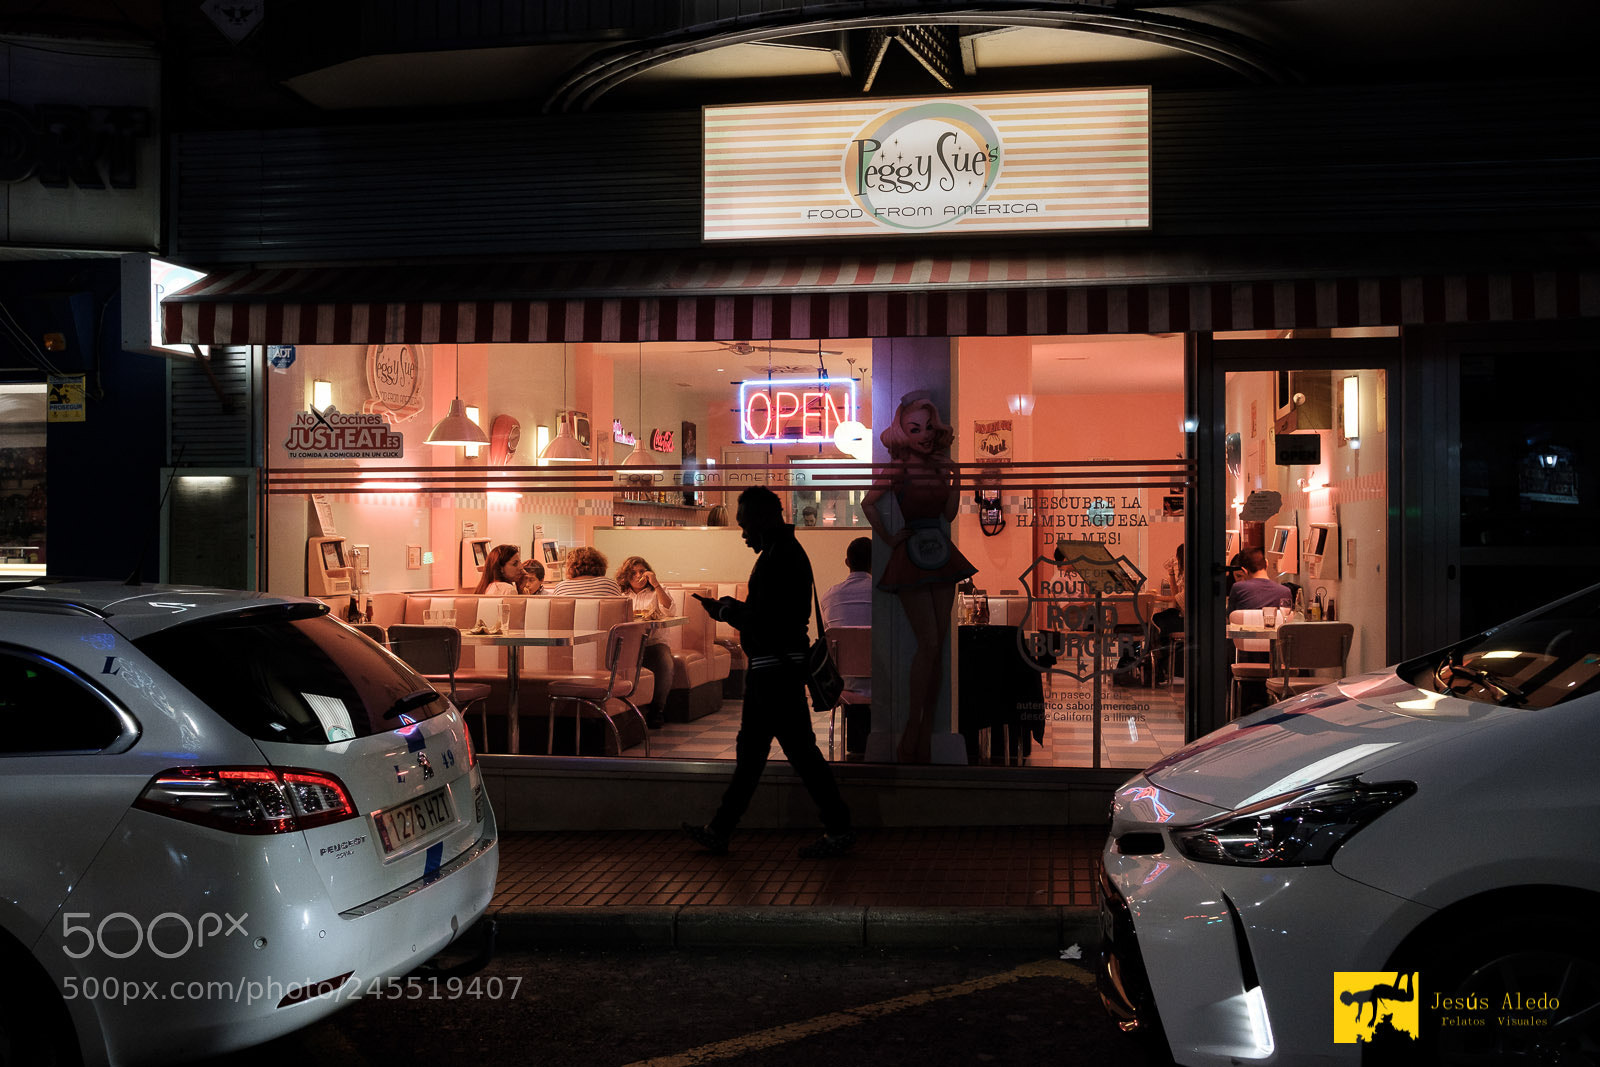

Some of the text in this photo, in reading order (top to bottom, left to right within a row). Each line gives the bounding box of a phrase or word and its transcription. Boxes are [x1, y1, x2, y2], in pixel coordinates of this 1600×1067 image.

[852, 131, 999, 196] Peggy Sue's
[807, 202, 1039, 220] FOOD FROM AMERICA
[273, 348, 292, 358] ADT
[296, 411, 381, 426] No Cocines
[747, 391, 850, 439] OPEN
[672, 472, 721, 482] FROM
[728, 472, 806, 482] AMERICA
[1121, 496, 1143, 509] LA
[1015, 513, 1149, 527] HAMBURGUESA
[1081, 531, 1121, 545] MES!
[1040, 580, 1125, 595] ROUTE 66
[1047, 605, 1118, 630] ROAD
[1029, 632, 1136, 658] BURGER
[100, 655, 121, 676] L
[1044, 688, 1058, 699] Un
[1060, 691, 1091, 701] paseo
[1113, 690, 1122, 700] el
[1066, 701, 1094, 711] sabor
[1095, 701, 1150, 711] mericano
[1020, 711, 1146, 722] desde Californ a Illinois
[388, 791, 450, 842] 1276 HZT
[319, 834, 368, 857] PEUGEOT
